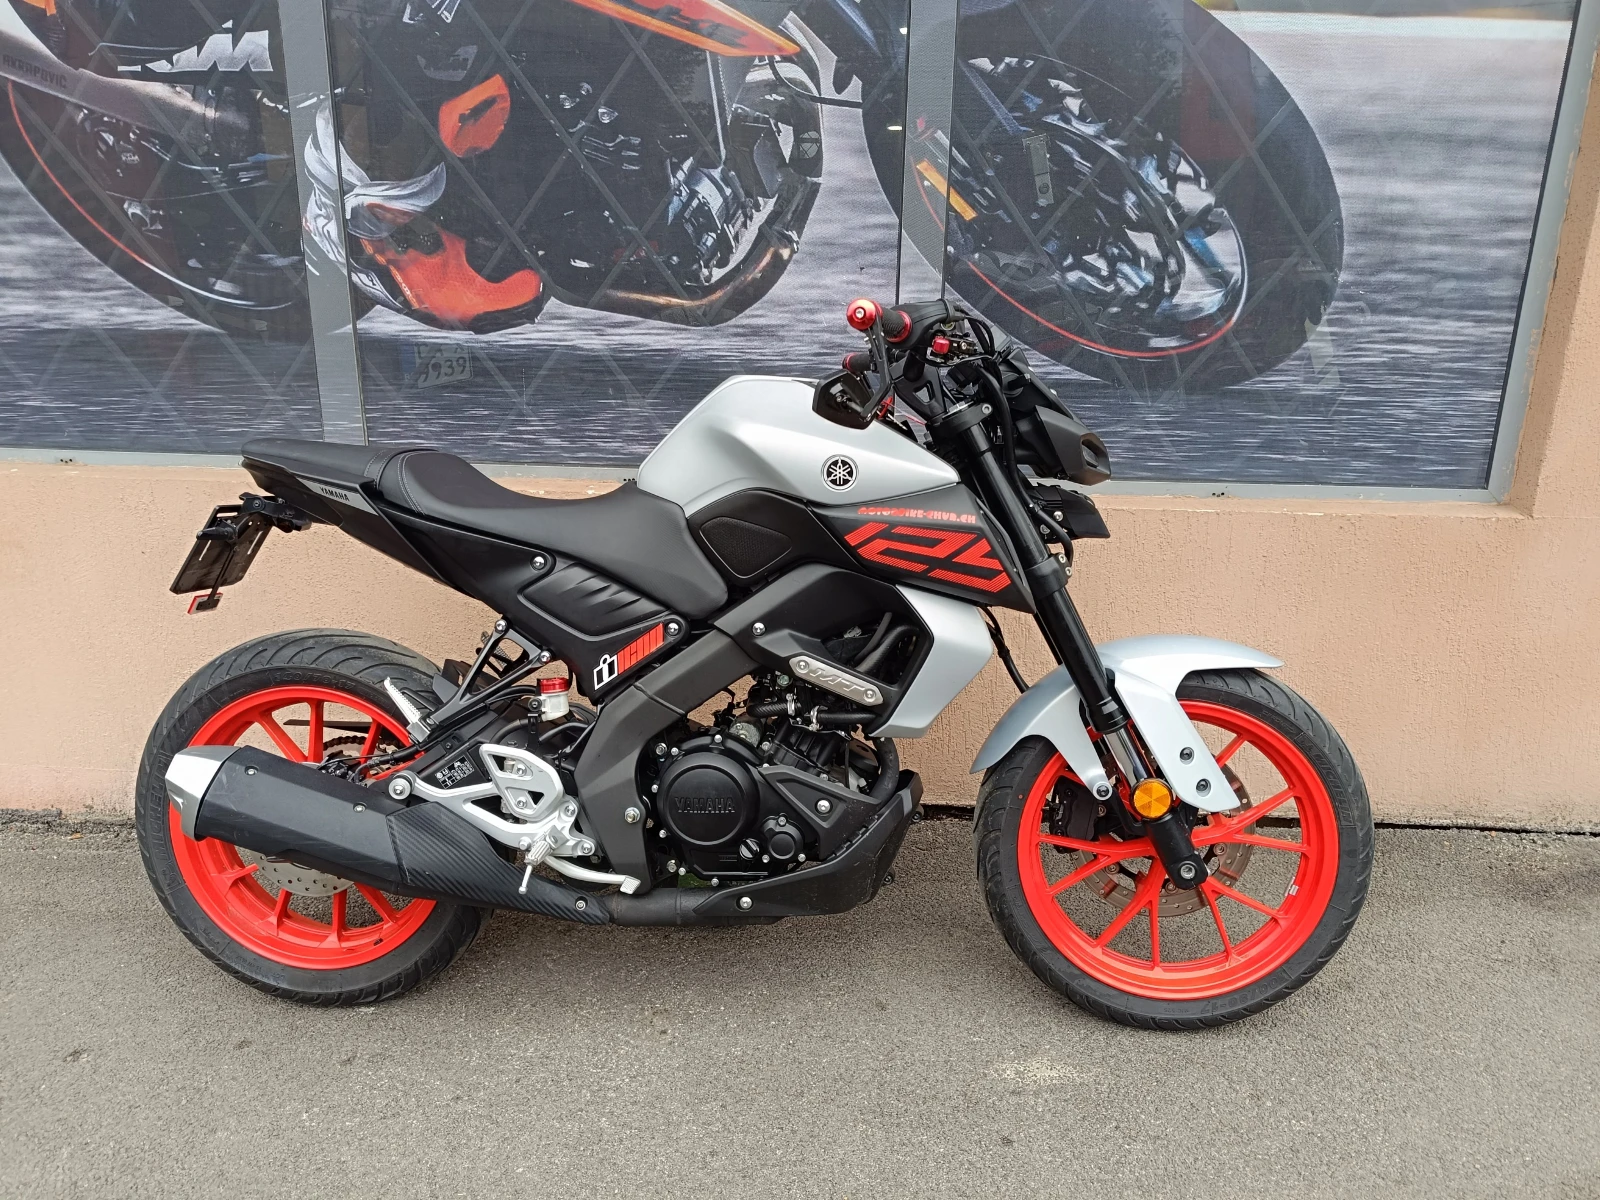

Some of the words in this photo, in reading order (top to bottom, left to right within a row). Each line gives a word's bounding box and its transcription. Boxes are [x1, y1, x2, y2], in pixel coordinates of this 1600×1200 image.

[319, 486, 350, 501] YAMAHA
[844, 521, 1012, 593] 125
[674, 796, 736, 814] YAMAHA
[1311, 752, 1355, 826] MICHELIN
